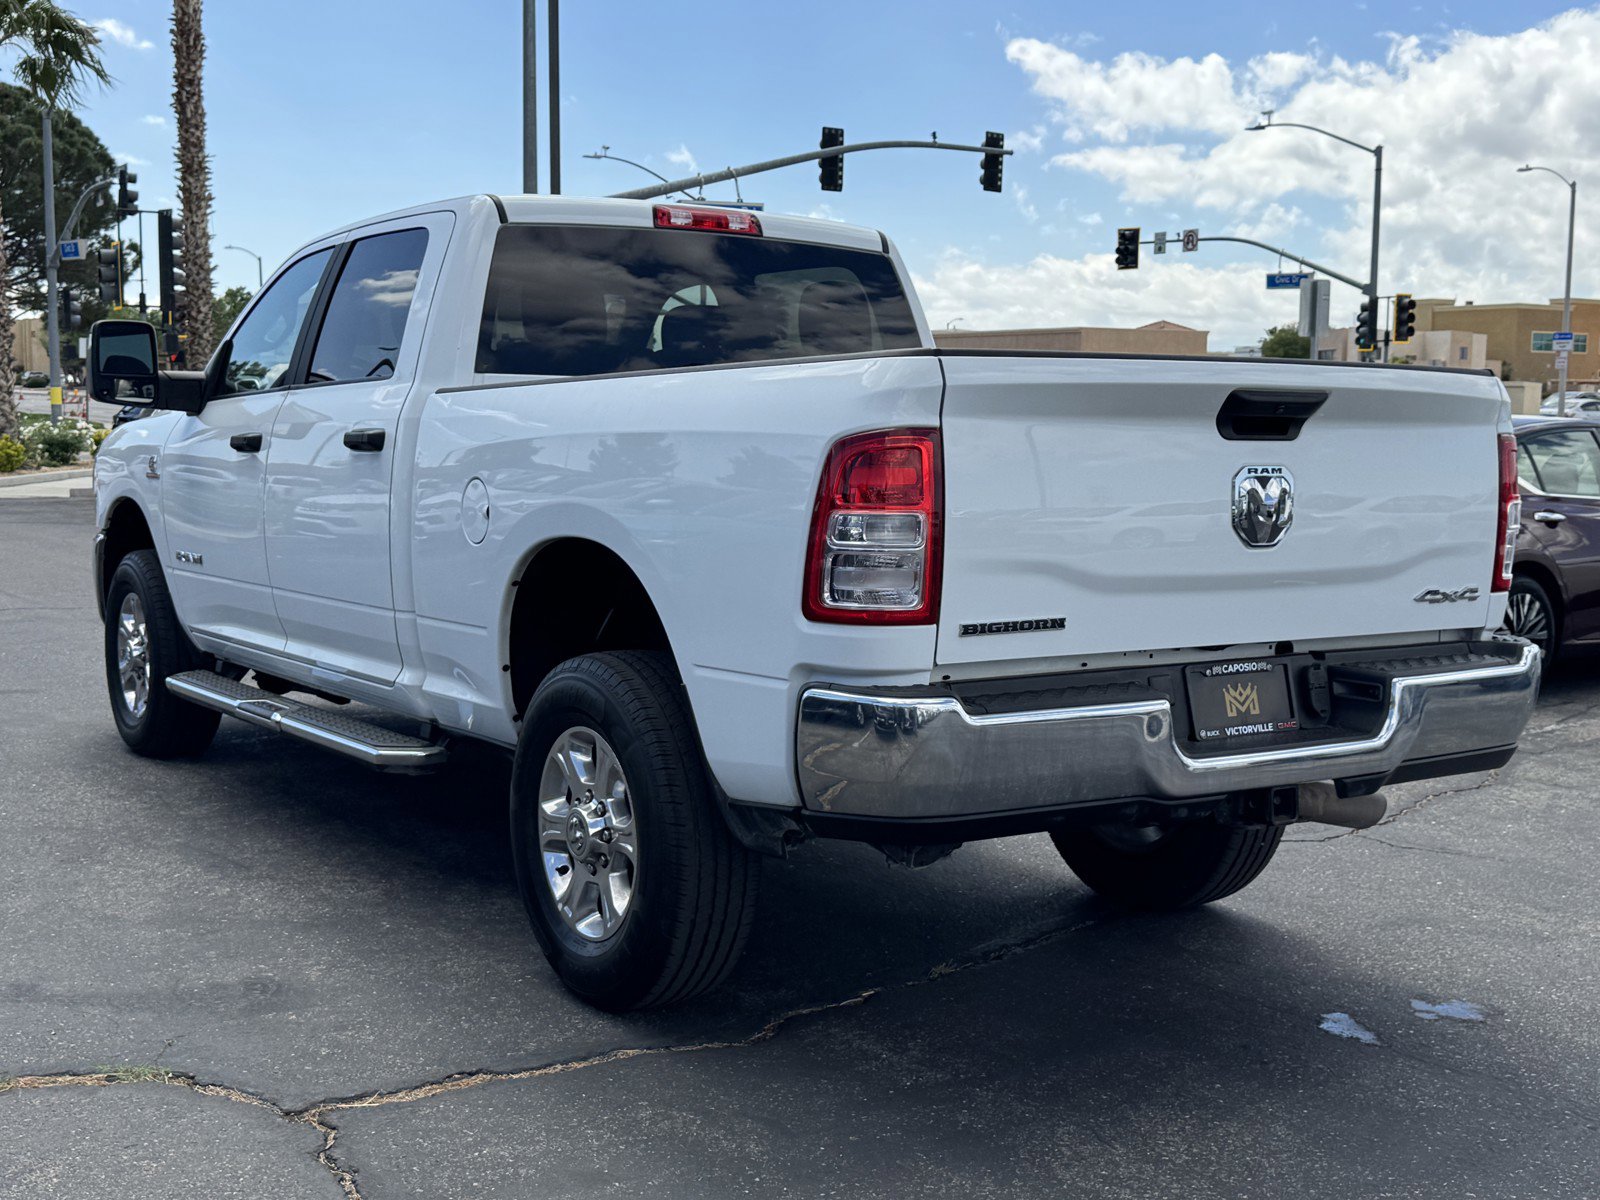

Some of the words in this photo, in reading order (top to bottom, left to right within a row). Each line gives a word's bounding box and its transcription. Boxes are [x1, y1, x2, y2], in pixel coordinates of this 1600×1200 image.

[175, 549, 204, 565] RAM
[958, 617, 1067, 637] BIGHORN
[1222, 662, 1258, 674] CAPOSIO
[1225, 723, 1273, 736] VICTORVILLE
[1277, 721, 1297, 729] GMC
